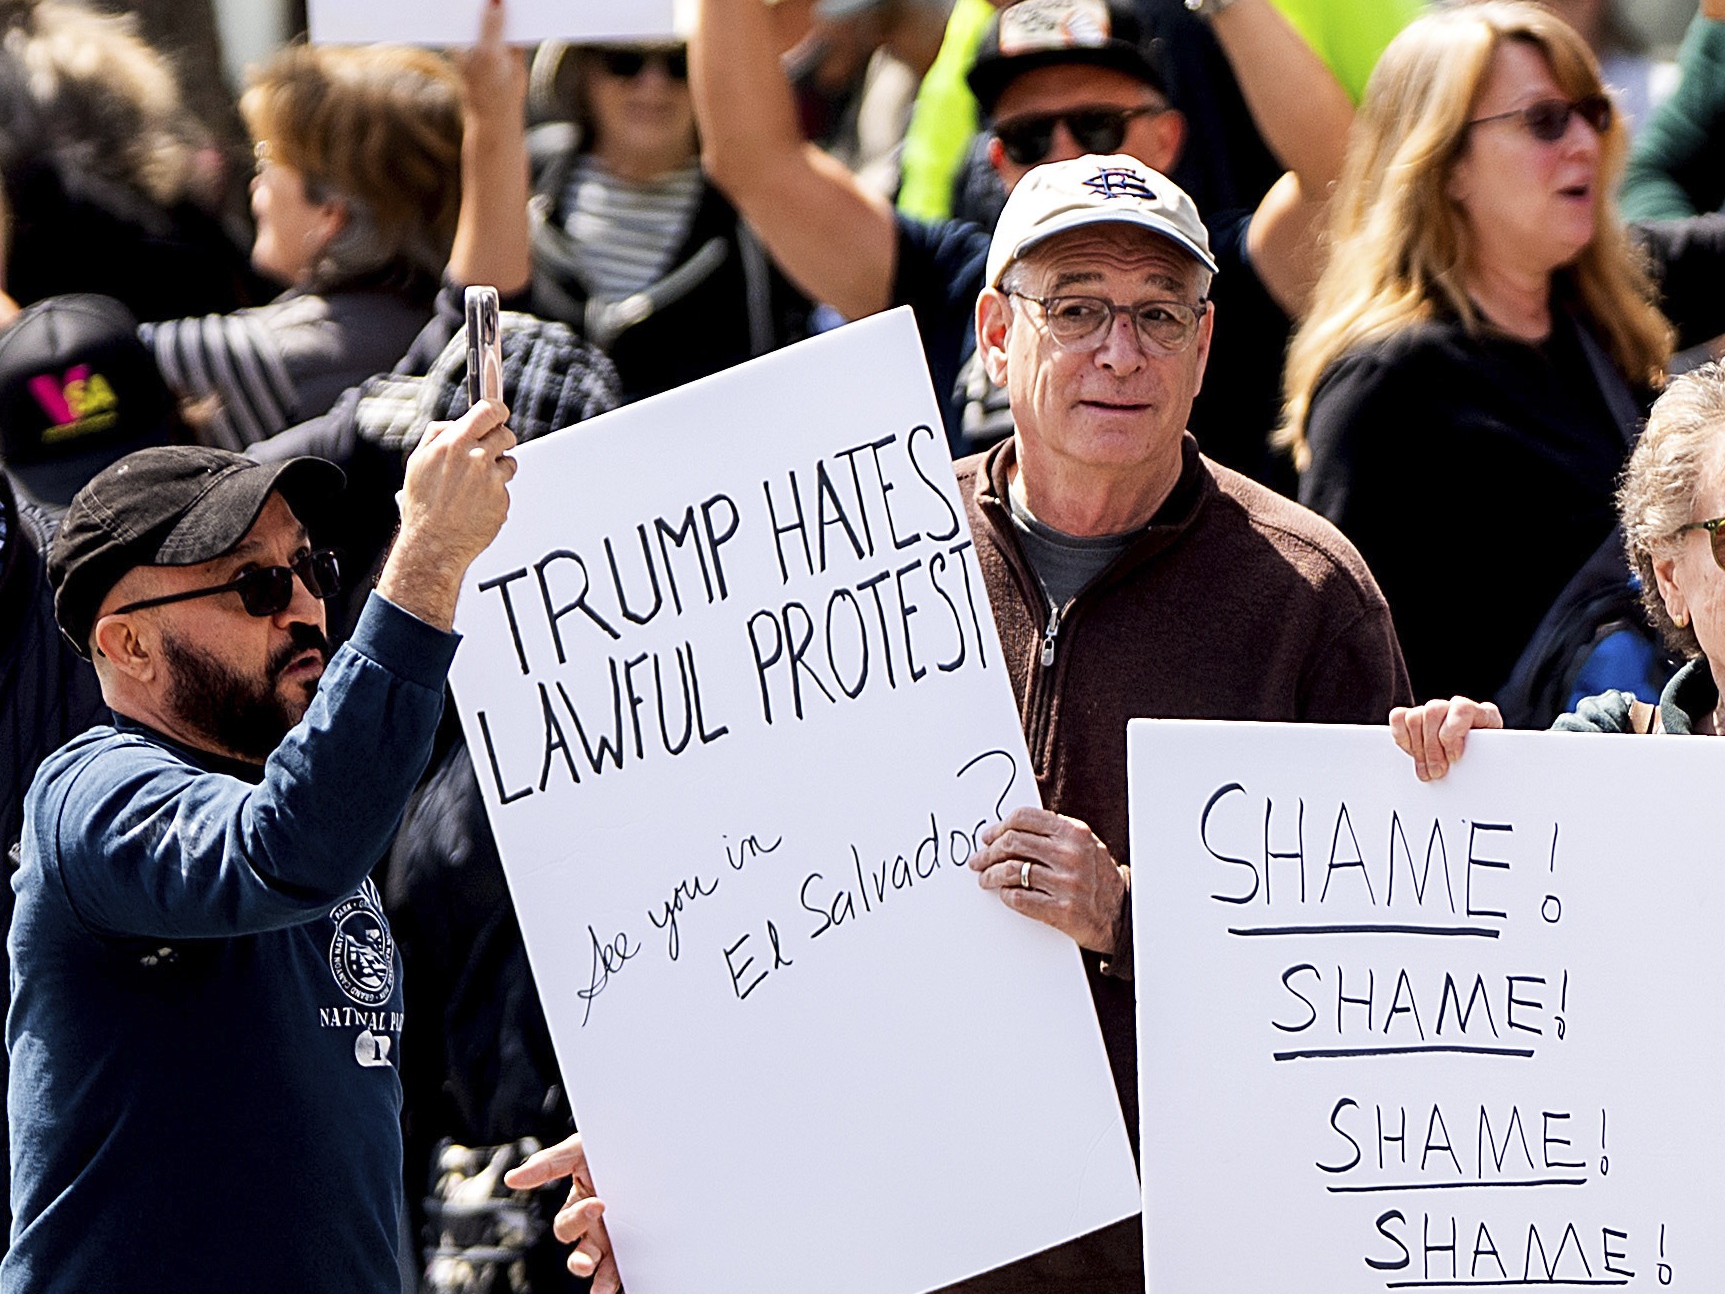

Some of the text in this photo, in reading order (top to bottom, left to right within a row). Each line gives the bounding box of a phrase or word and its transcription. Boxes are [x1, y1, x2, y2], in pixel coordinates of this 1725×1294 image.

[477, 424, 961, 676] TRUMP HATES
[476, 540, 988, 806] LAWFUL PROTEST
[648, 877, 719, 962] you
[722, 833, 783, 872] in
[722, 920, 794, 1000] El
[1271, 963, 1568, 1041] SHAME!
[1315, 1098, 1611, 1178] SHAME!
[1364, 1209, 1673, 1286] SHAME!
